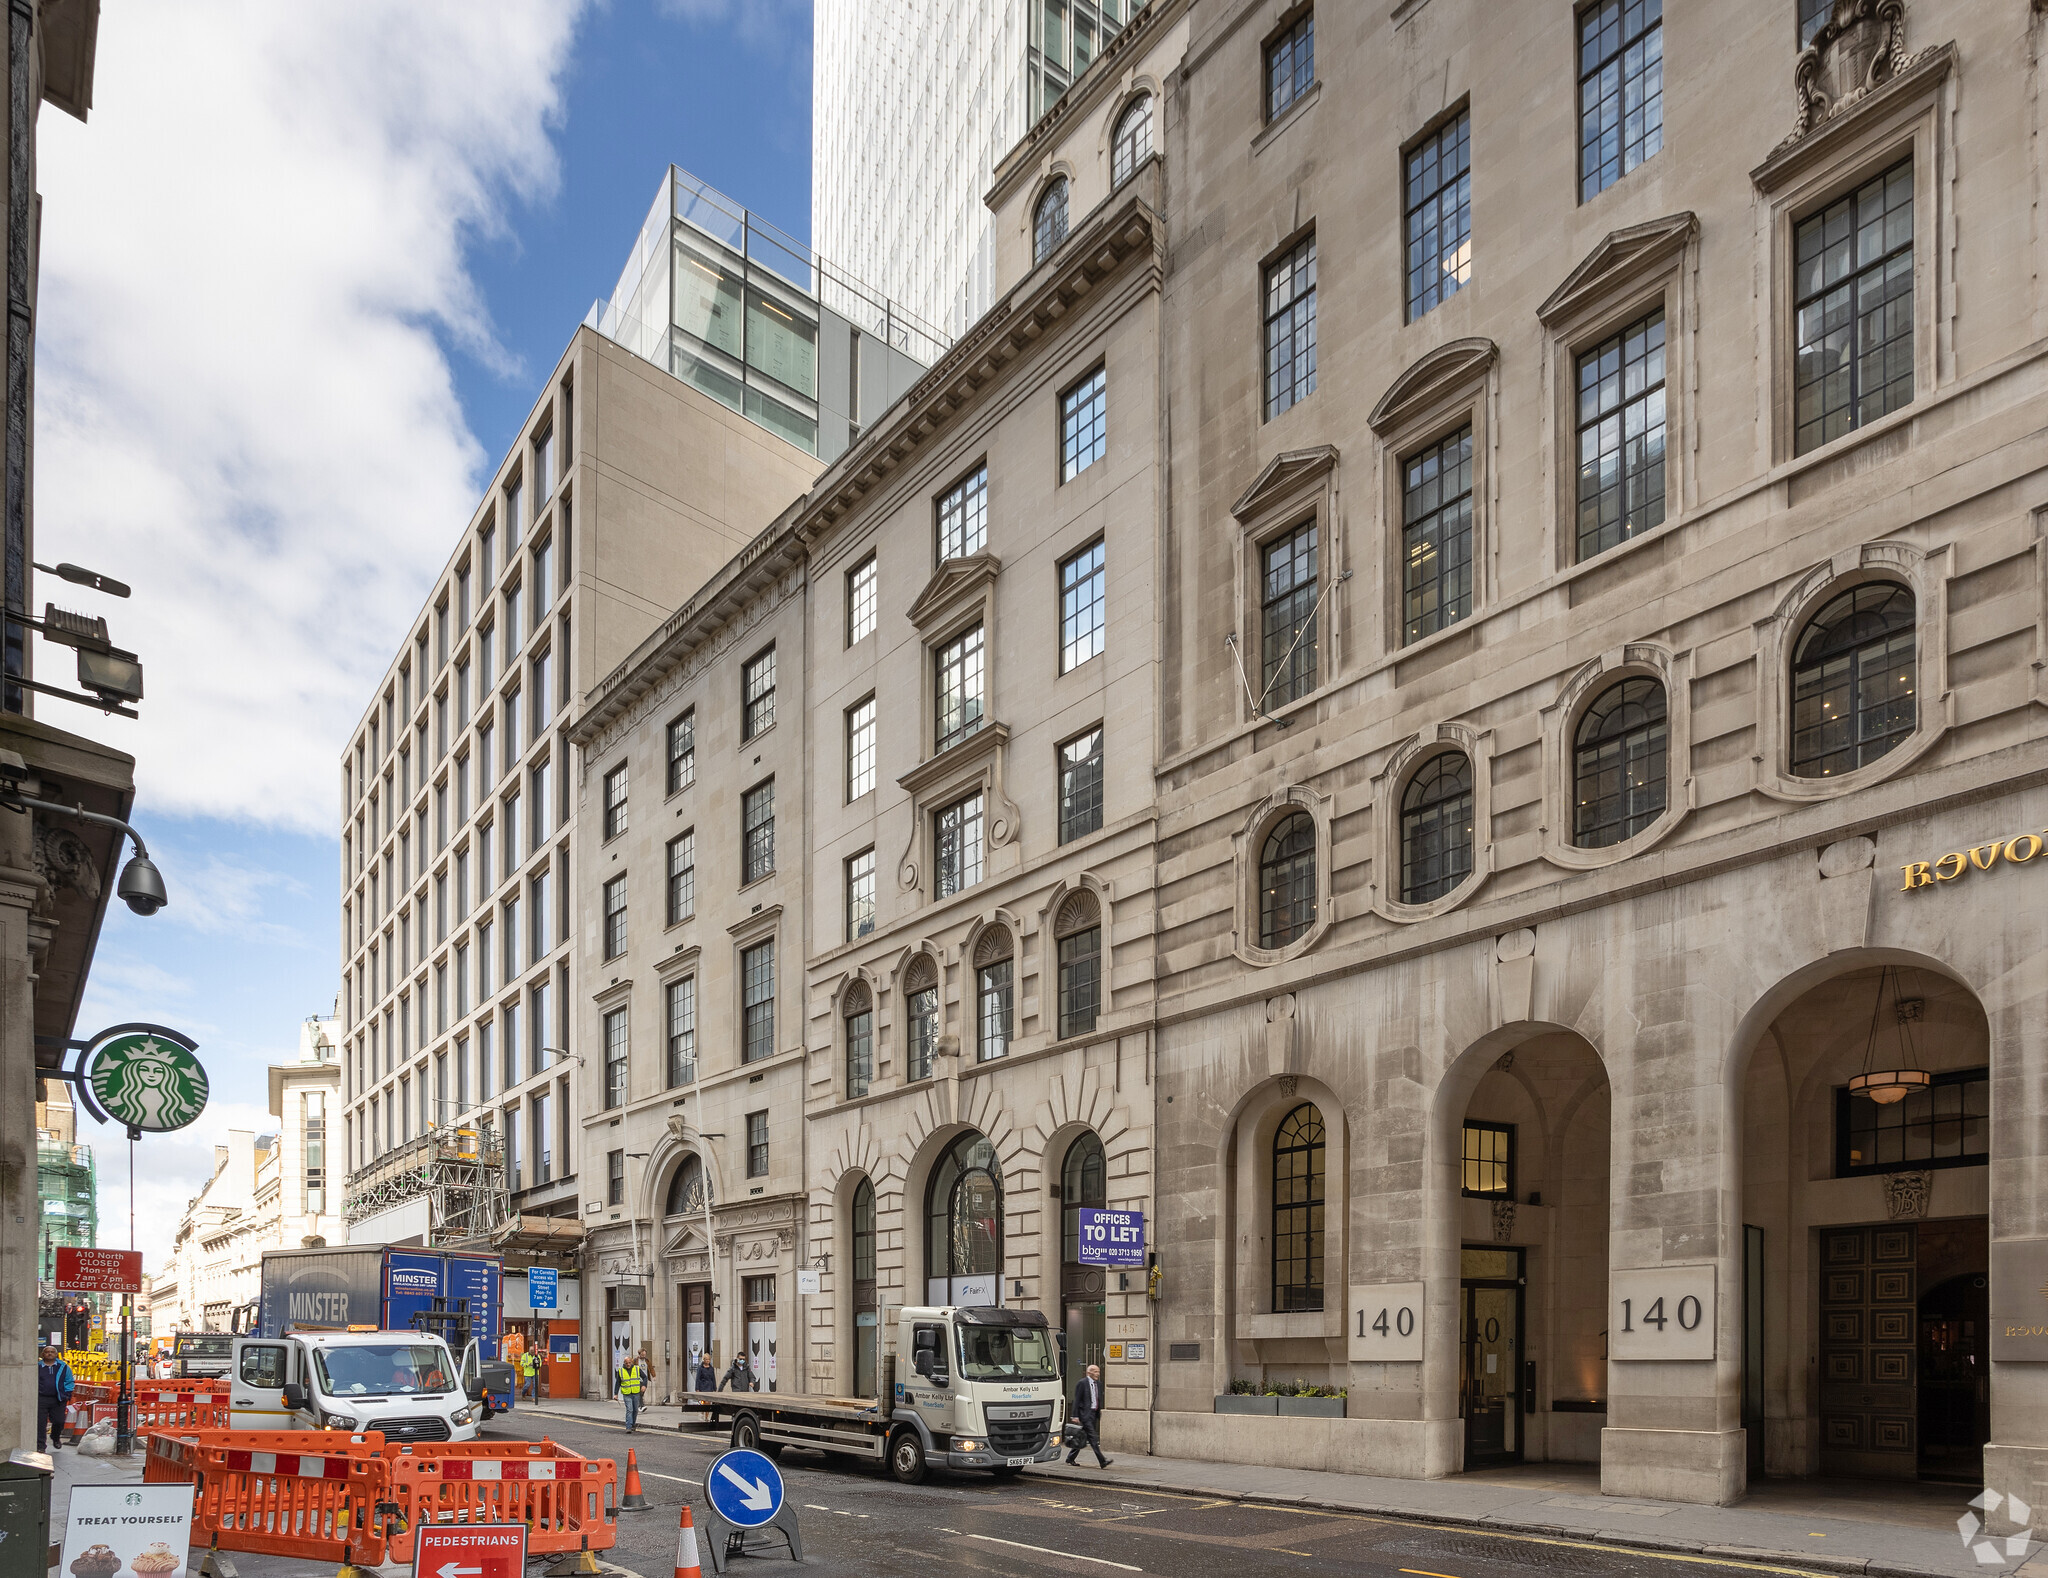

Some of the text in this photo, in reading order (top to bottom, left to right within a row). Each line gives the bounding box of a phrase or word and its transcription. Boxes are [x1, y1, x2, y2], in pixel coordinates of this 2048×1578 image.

[1900, 829, 2048, 891] REVO
[1094, 1213, 1130, 1225] OFFICES
[1084, 1225, 1140, 1242] TO LET
[80, 1259, 120, 1267] CLOSED
[393, 1274, 437, 1284] MINSTER
[289, 1292, 348, 1321] MINSTER
[1621, 1295, 1702, 1332] 140
[1118, 1324, 1135, 1333] 145
[1356, 1307, 1414, 1338] 140
[77, 1515, 184, 1525] TREAT YOURSELF
[425, 1536, 519, 1546] PEDESTRIANS
